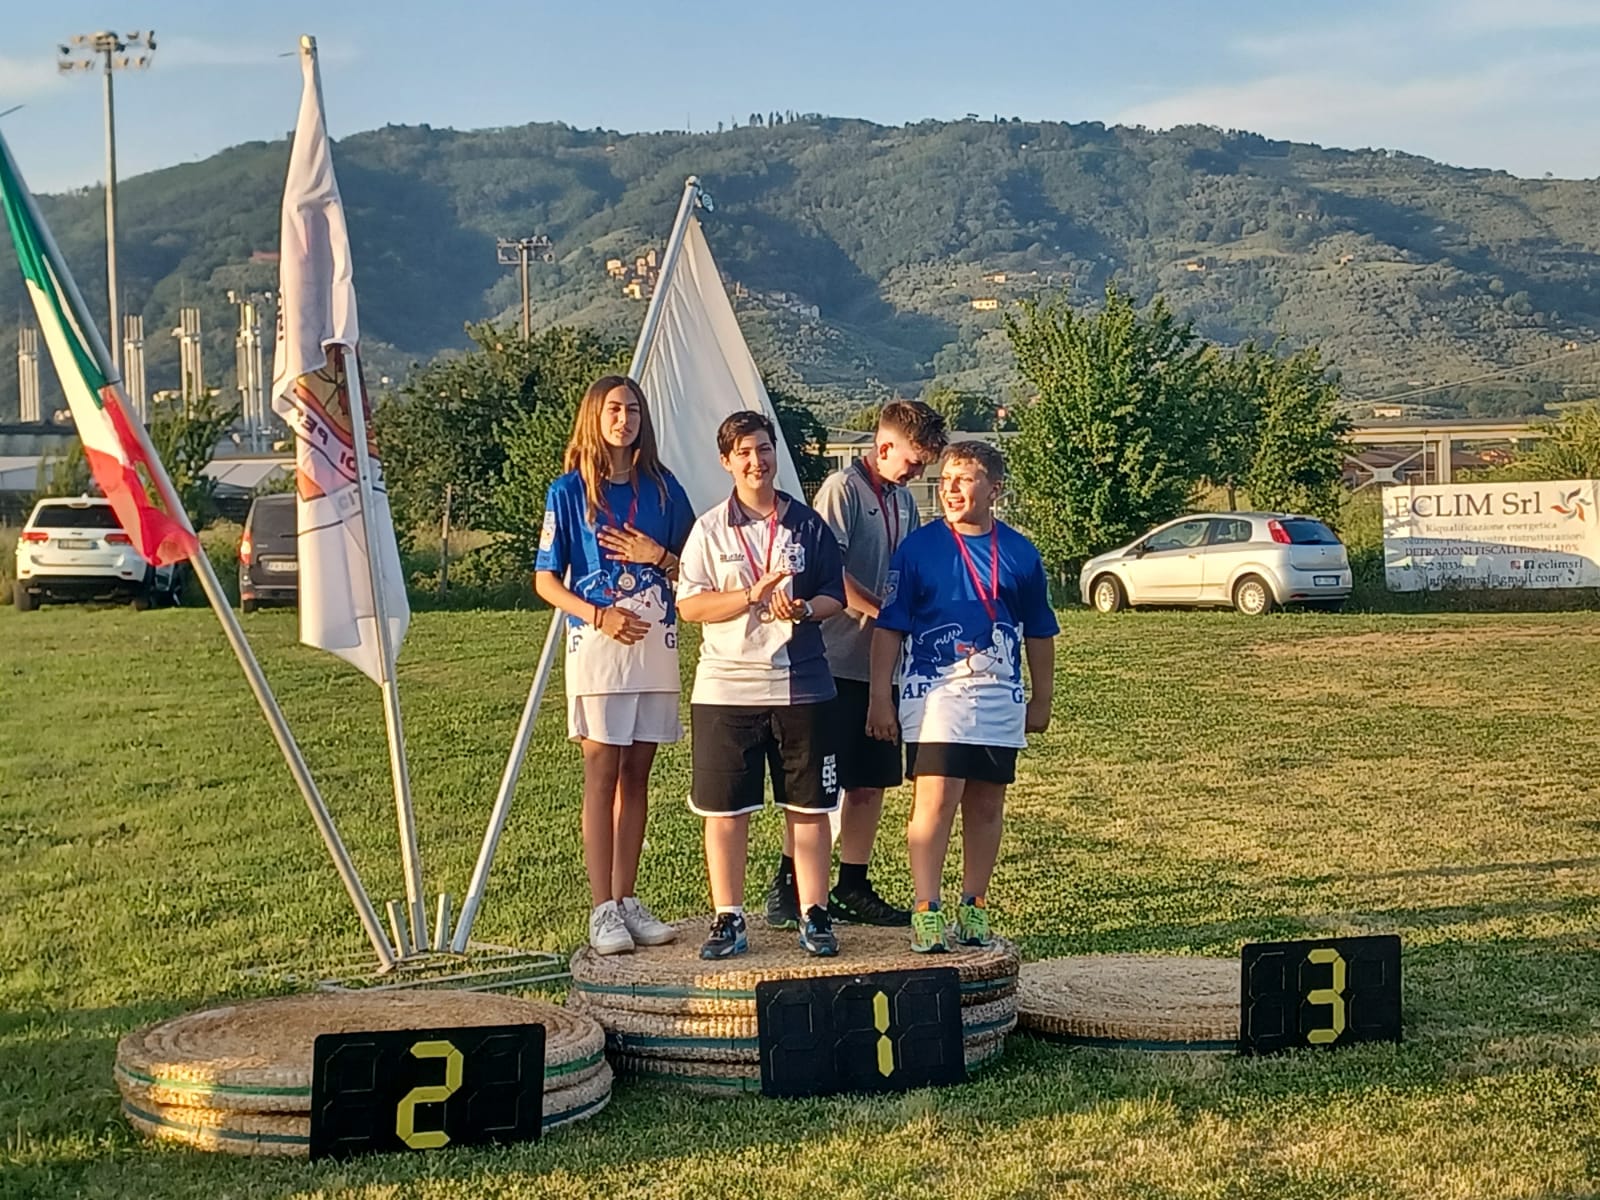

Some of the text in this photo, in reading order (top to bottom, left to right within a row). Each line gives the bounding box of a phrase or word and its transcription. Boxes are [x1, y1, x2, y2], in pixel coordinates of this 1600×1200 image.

[1393, 491, 1541, 518] ECLIM Srl
[1507, 521, 1558, 532] energetica
[1405, 546, 1472, 557] DETRAZIONI
[1474, 545, 1518, 556] FISCALI
[1538, 558, 1583, 570] eclimsrl
[822, 765, 837, 787] 95
[1307, 948, 1346, 1044] 3
[873, 990, 894, 1078] 1
[396, 1040, 464, 1149] 2
